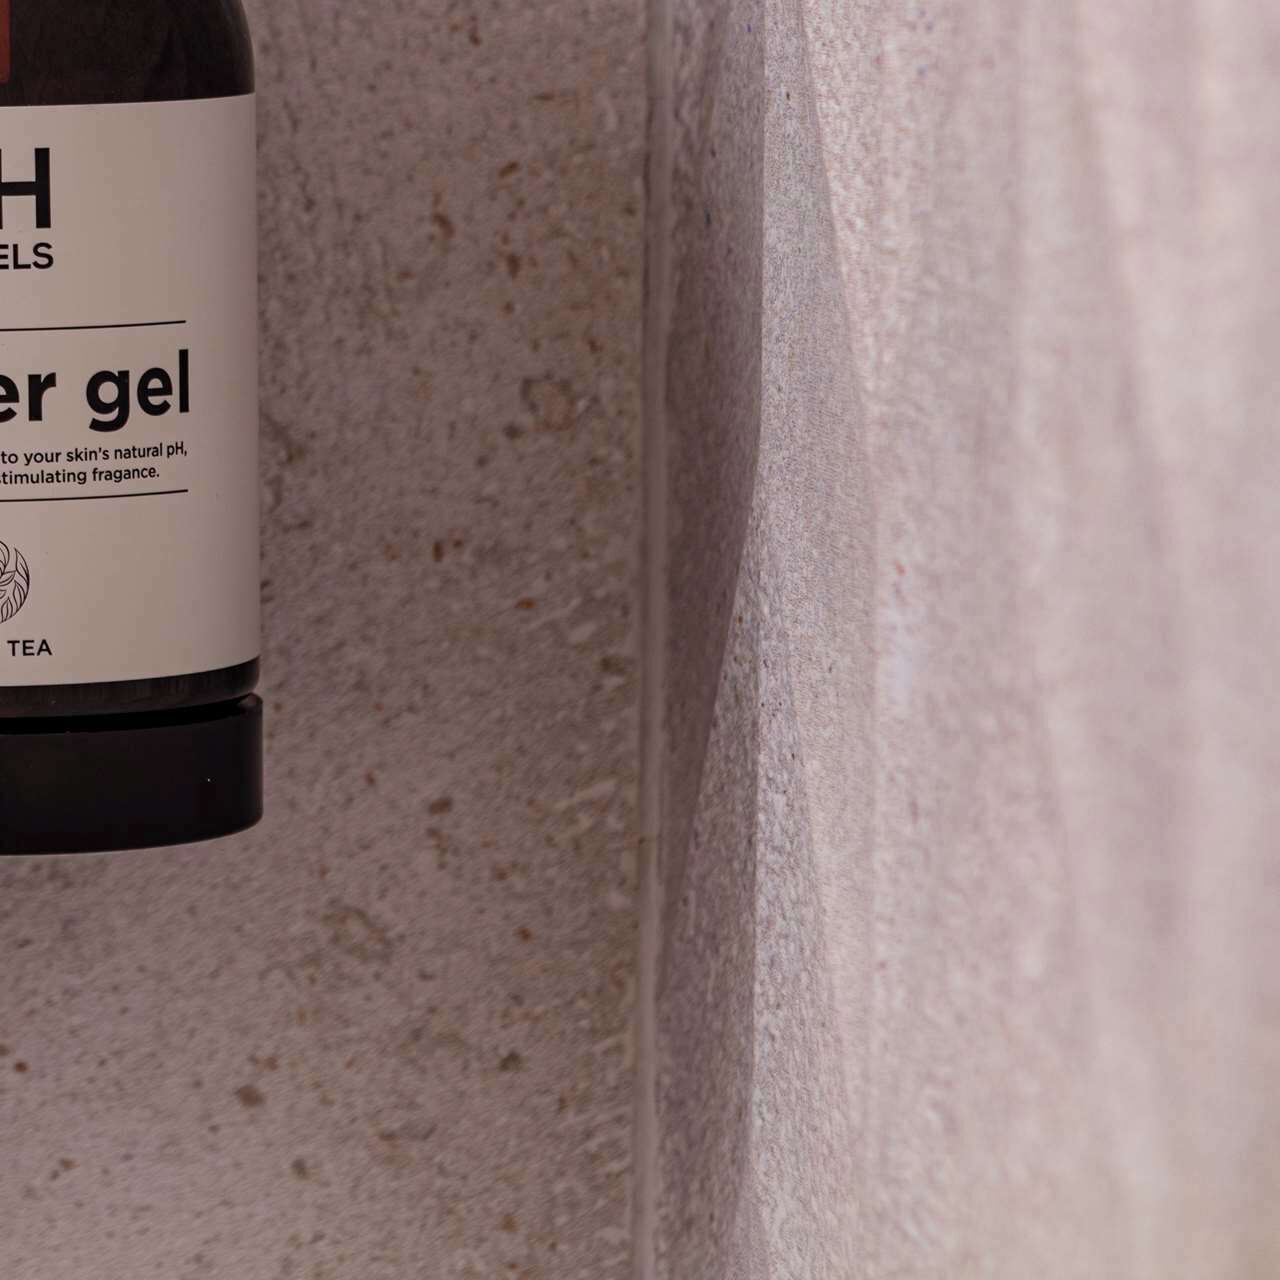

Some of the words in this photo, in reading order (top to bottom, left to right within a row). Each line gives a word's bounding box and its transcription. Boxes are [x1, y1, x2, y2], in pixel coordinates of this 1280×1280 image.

[85, 348, 190, 433] gel
[0, 450, 20, 465] to
[23, 451, 63, 467] your
[113, 441, 164, 461] natural
[166, 440, 188, 460] pH,
[91, 466, 160, 484] fragance.
[6, 638, 53, 657] TEA
